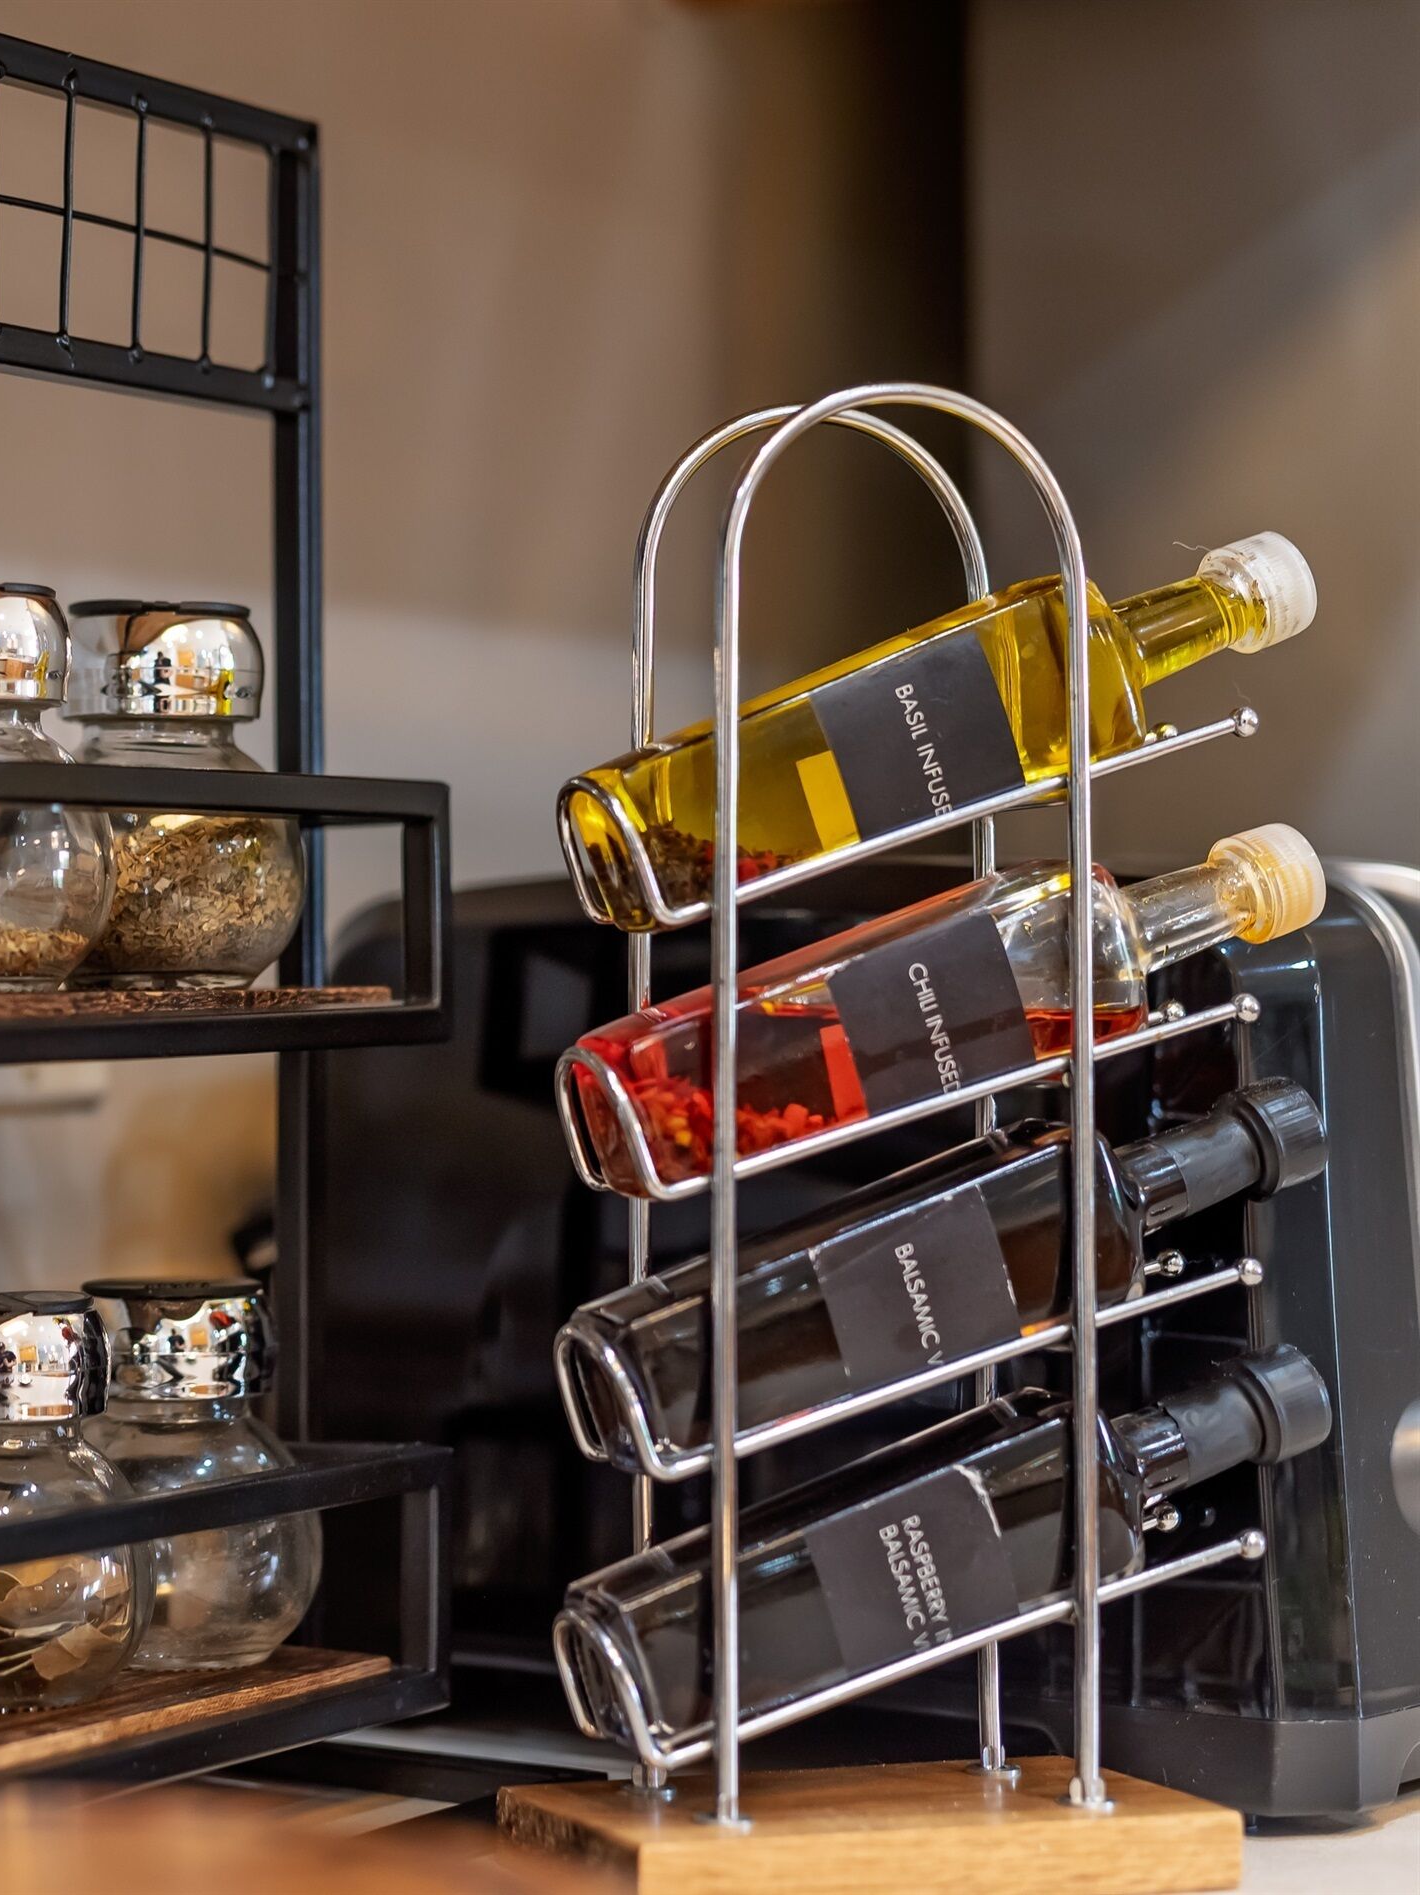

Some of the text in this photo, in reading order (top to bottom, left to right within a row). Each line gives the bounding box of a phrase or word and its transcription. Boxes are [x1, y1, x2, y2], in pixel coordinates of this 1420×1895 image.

[894, 683, 928, 740] BASIL
[908, 962, 939, 1012] CHILI
[894, 1242, 941, 1349] BALSAMIC
[879, 1524, 926, 1630] BALSAMIC
[901, 1514, 949, 1622] RASPBERRY
